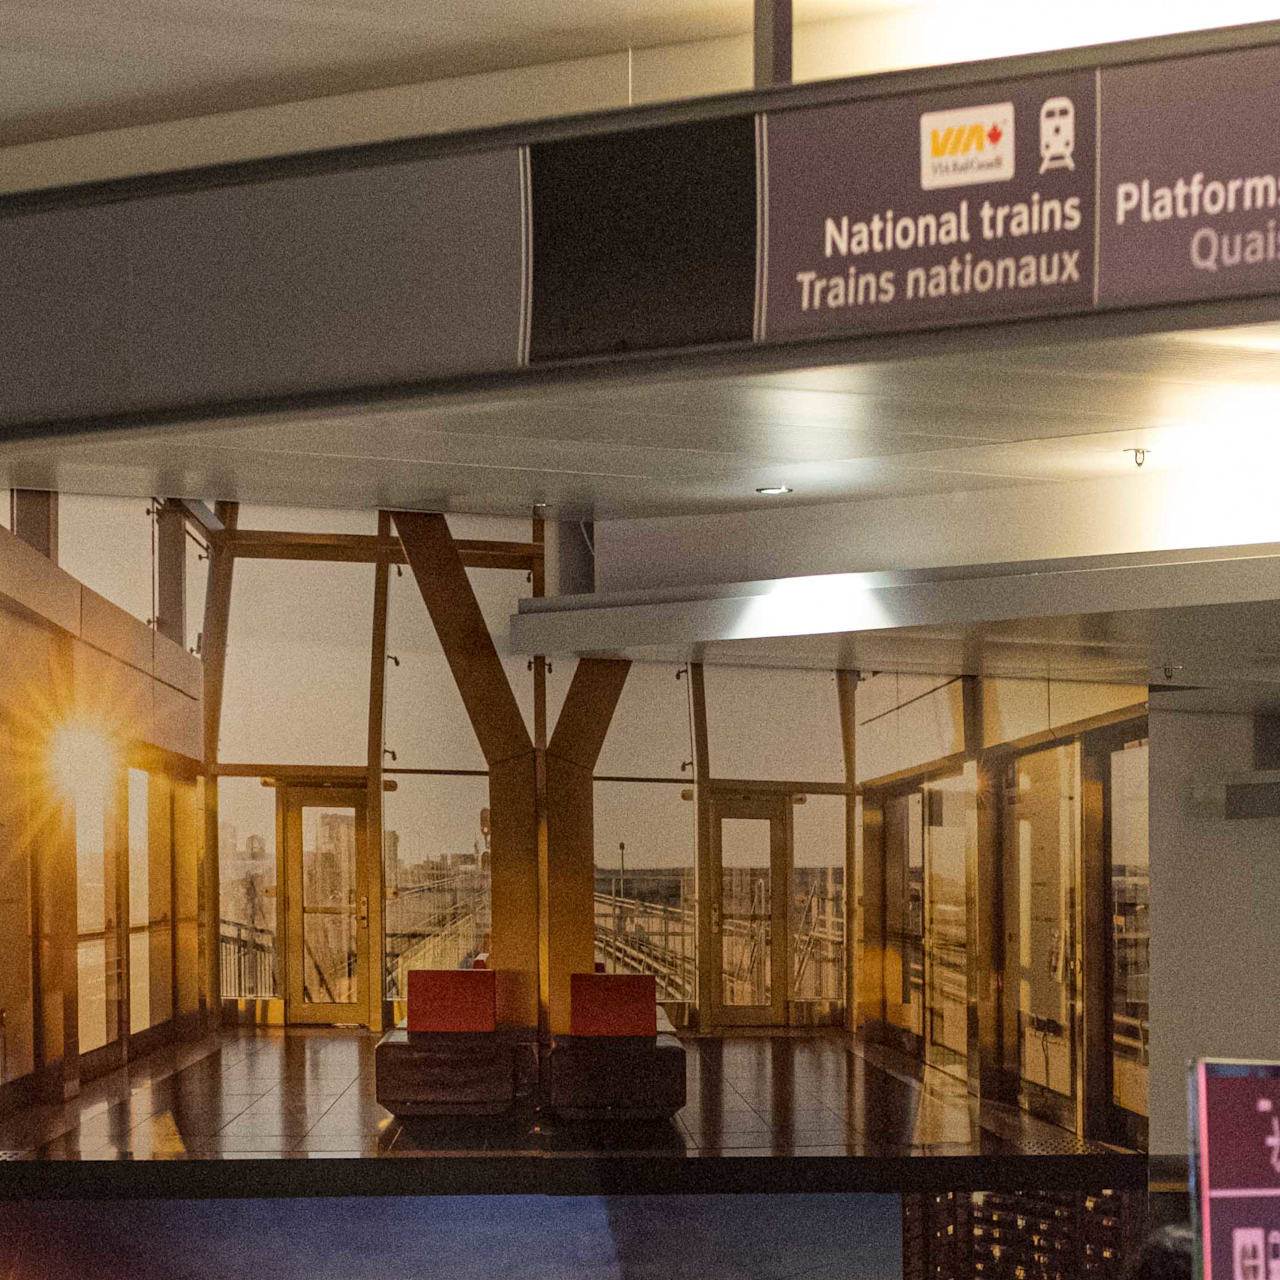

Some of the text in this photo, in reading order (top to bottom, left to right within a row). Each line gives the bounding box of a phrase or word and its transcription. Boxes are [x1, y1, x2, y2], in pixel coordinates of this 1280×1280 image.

[930, 123, 984, 158] VIA
[824, 191, 1082, 258] National trains
[796, 250, 1080, 311] Trains nationaux
